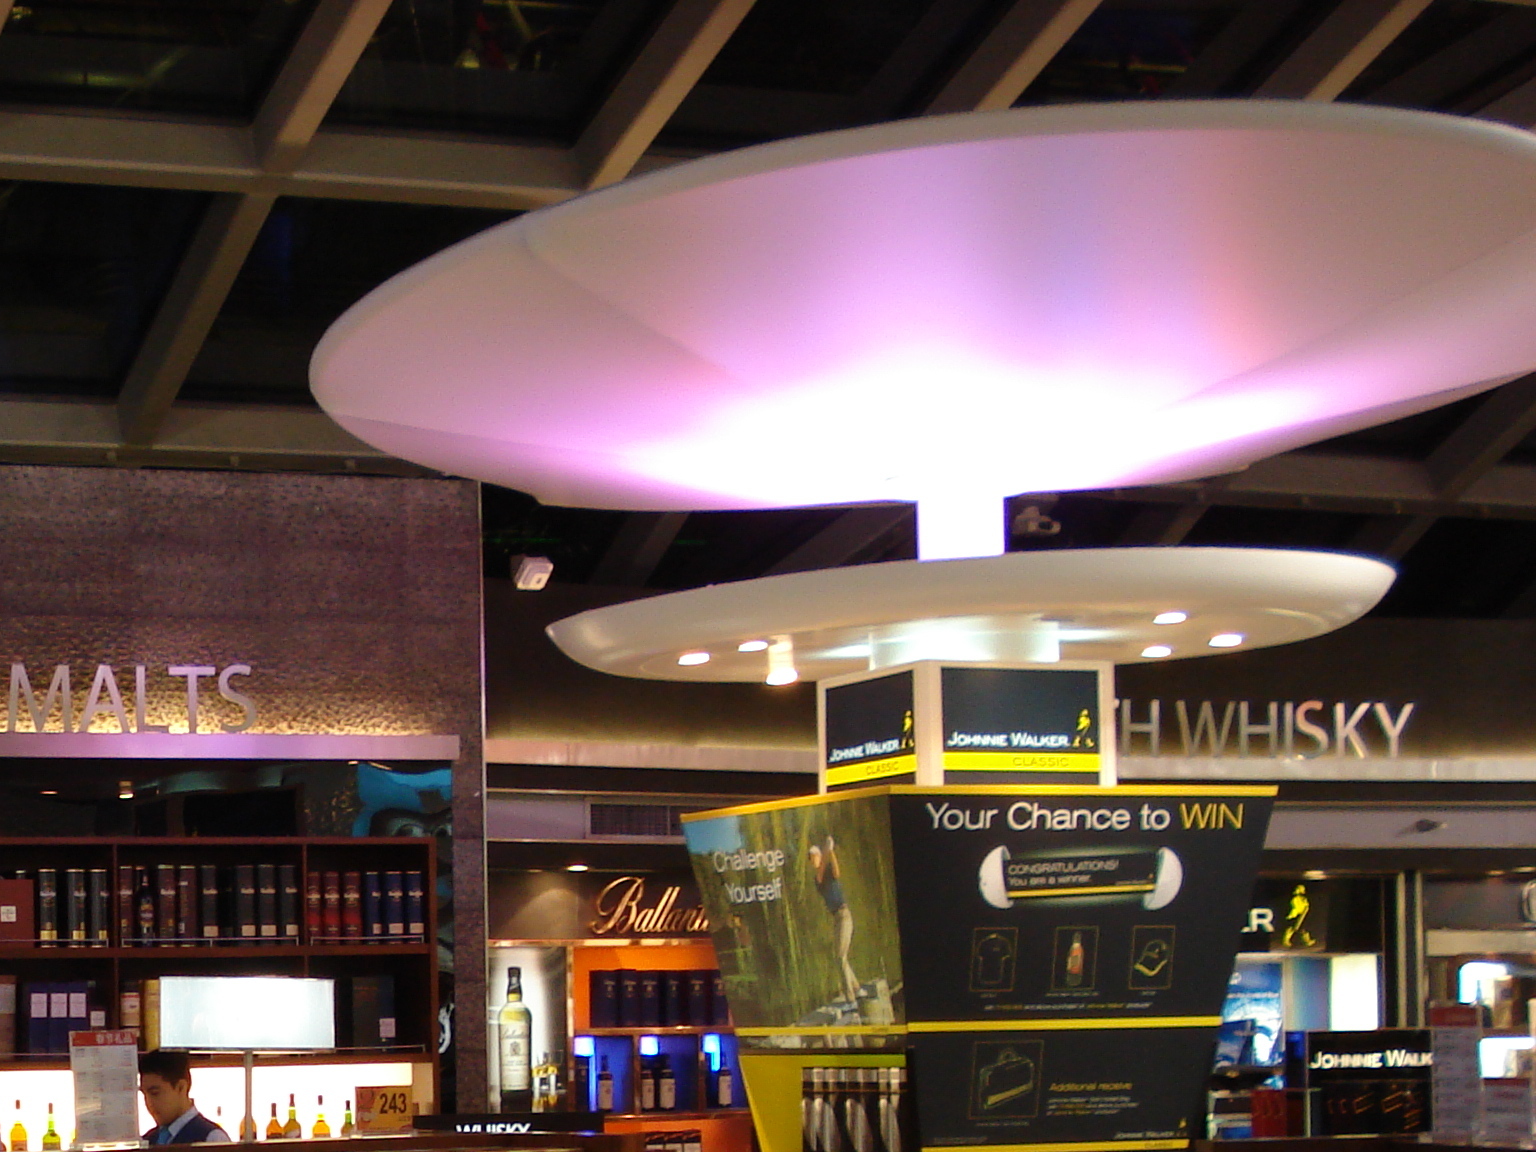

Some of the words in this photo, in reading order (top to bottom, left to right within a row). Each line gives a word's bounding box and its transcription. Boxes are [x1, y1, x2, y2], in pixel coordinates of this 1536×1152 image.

[6, 662, 258, 735] MALTS
[947, 731, 1008, 748] JOHNNIE
[1010, 731, 1070, 748] WALKER
[1175, 699, 1415, 761] WHISKY
[828, 741, 864, 763] JOHNNIE
[865, 738, 901, 757] WALKER
[1012, 757, 1069, 768] CLASSIC
[865, 761, 899, 776] CLASSIC
[926, 802, 998, 830] Your
[1007, 801, 1130, 831] Chance
[1139, 803, 1171, 831] to
[1179, 802, 1245, 830] WIN
[713, 848, 784, 873] Challenge
[725, 877, 782, 903] Yourself
[1241, 907, 1275, 933] R
[1309, 1051, 1383, 1070] JOHNNIE
[379, 1093, 407, 1114] 243
